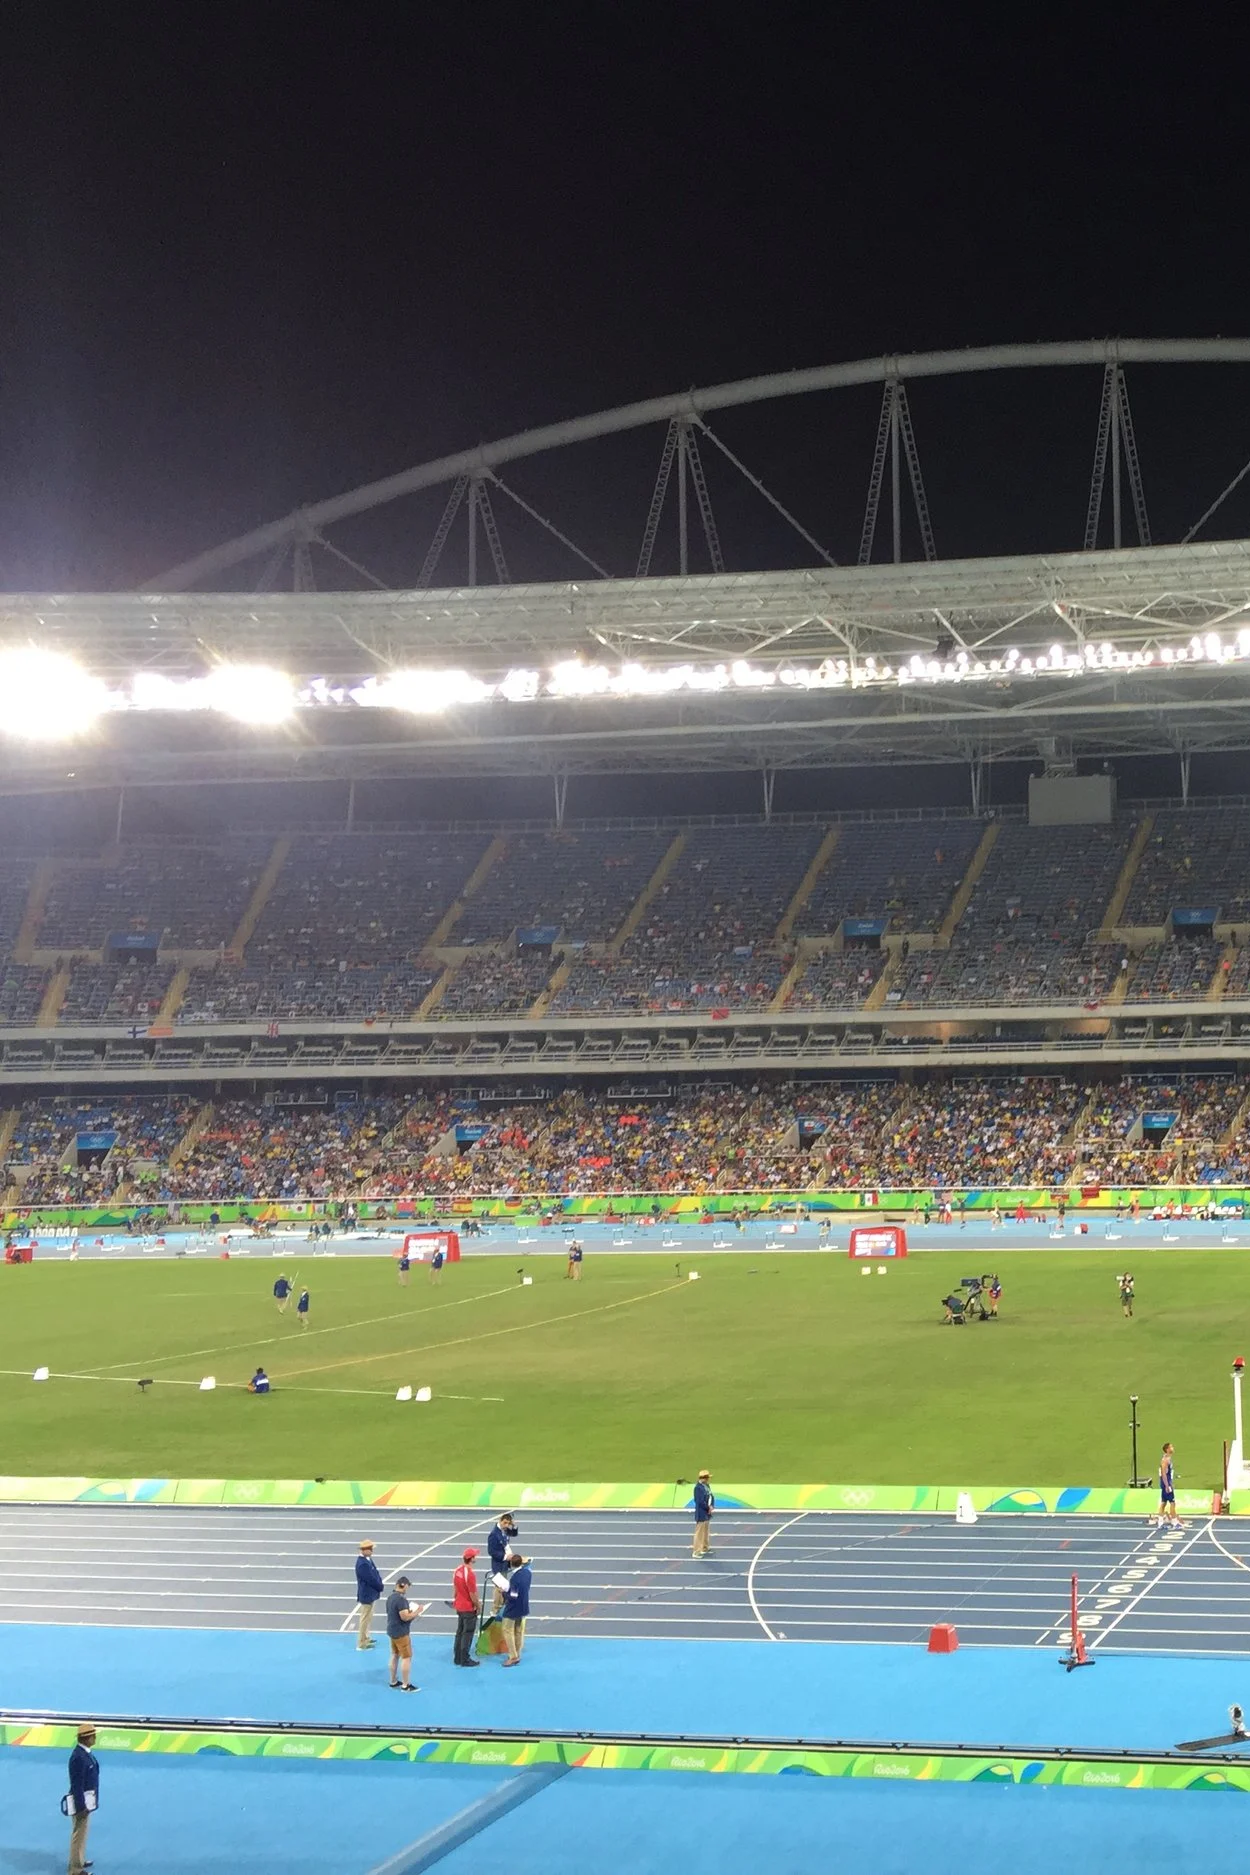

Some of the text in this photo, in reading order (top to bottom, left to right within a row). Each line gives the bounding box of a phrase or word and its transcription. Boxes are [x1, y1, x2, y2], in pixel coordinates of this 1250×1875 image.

[1161, 1531, 1186, 1540] 2
[1149, 1543, 1174, 1552] 3
[1135, 1556, 1160, 1565] 4
[1122, 1569, 1148, 1579] 5
[1108, 1584, 1134, 1593] 6
[1095, 1599, 1121, 1609] 7
[1076, 1615, 1103, 1626] 8
